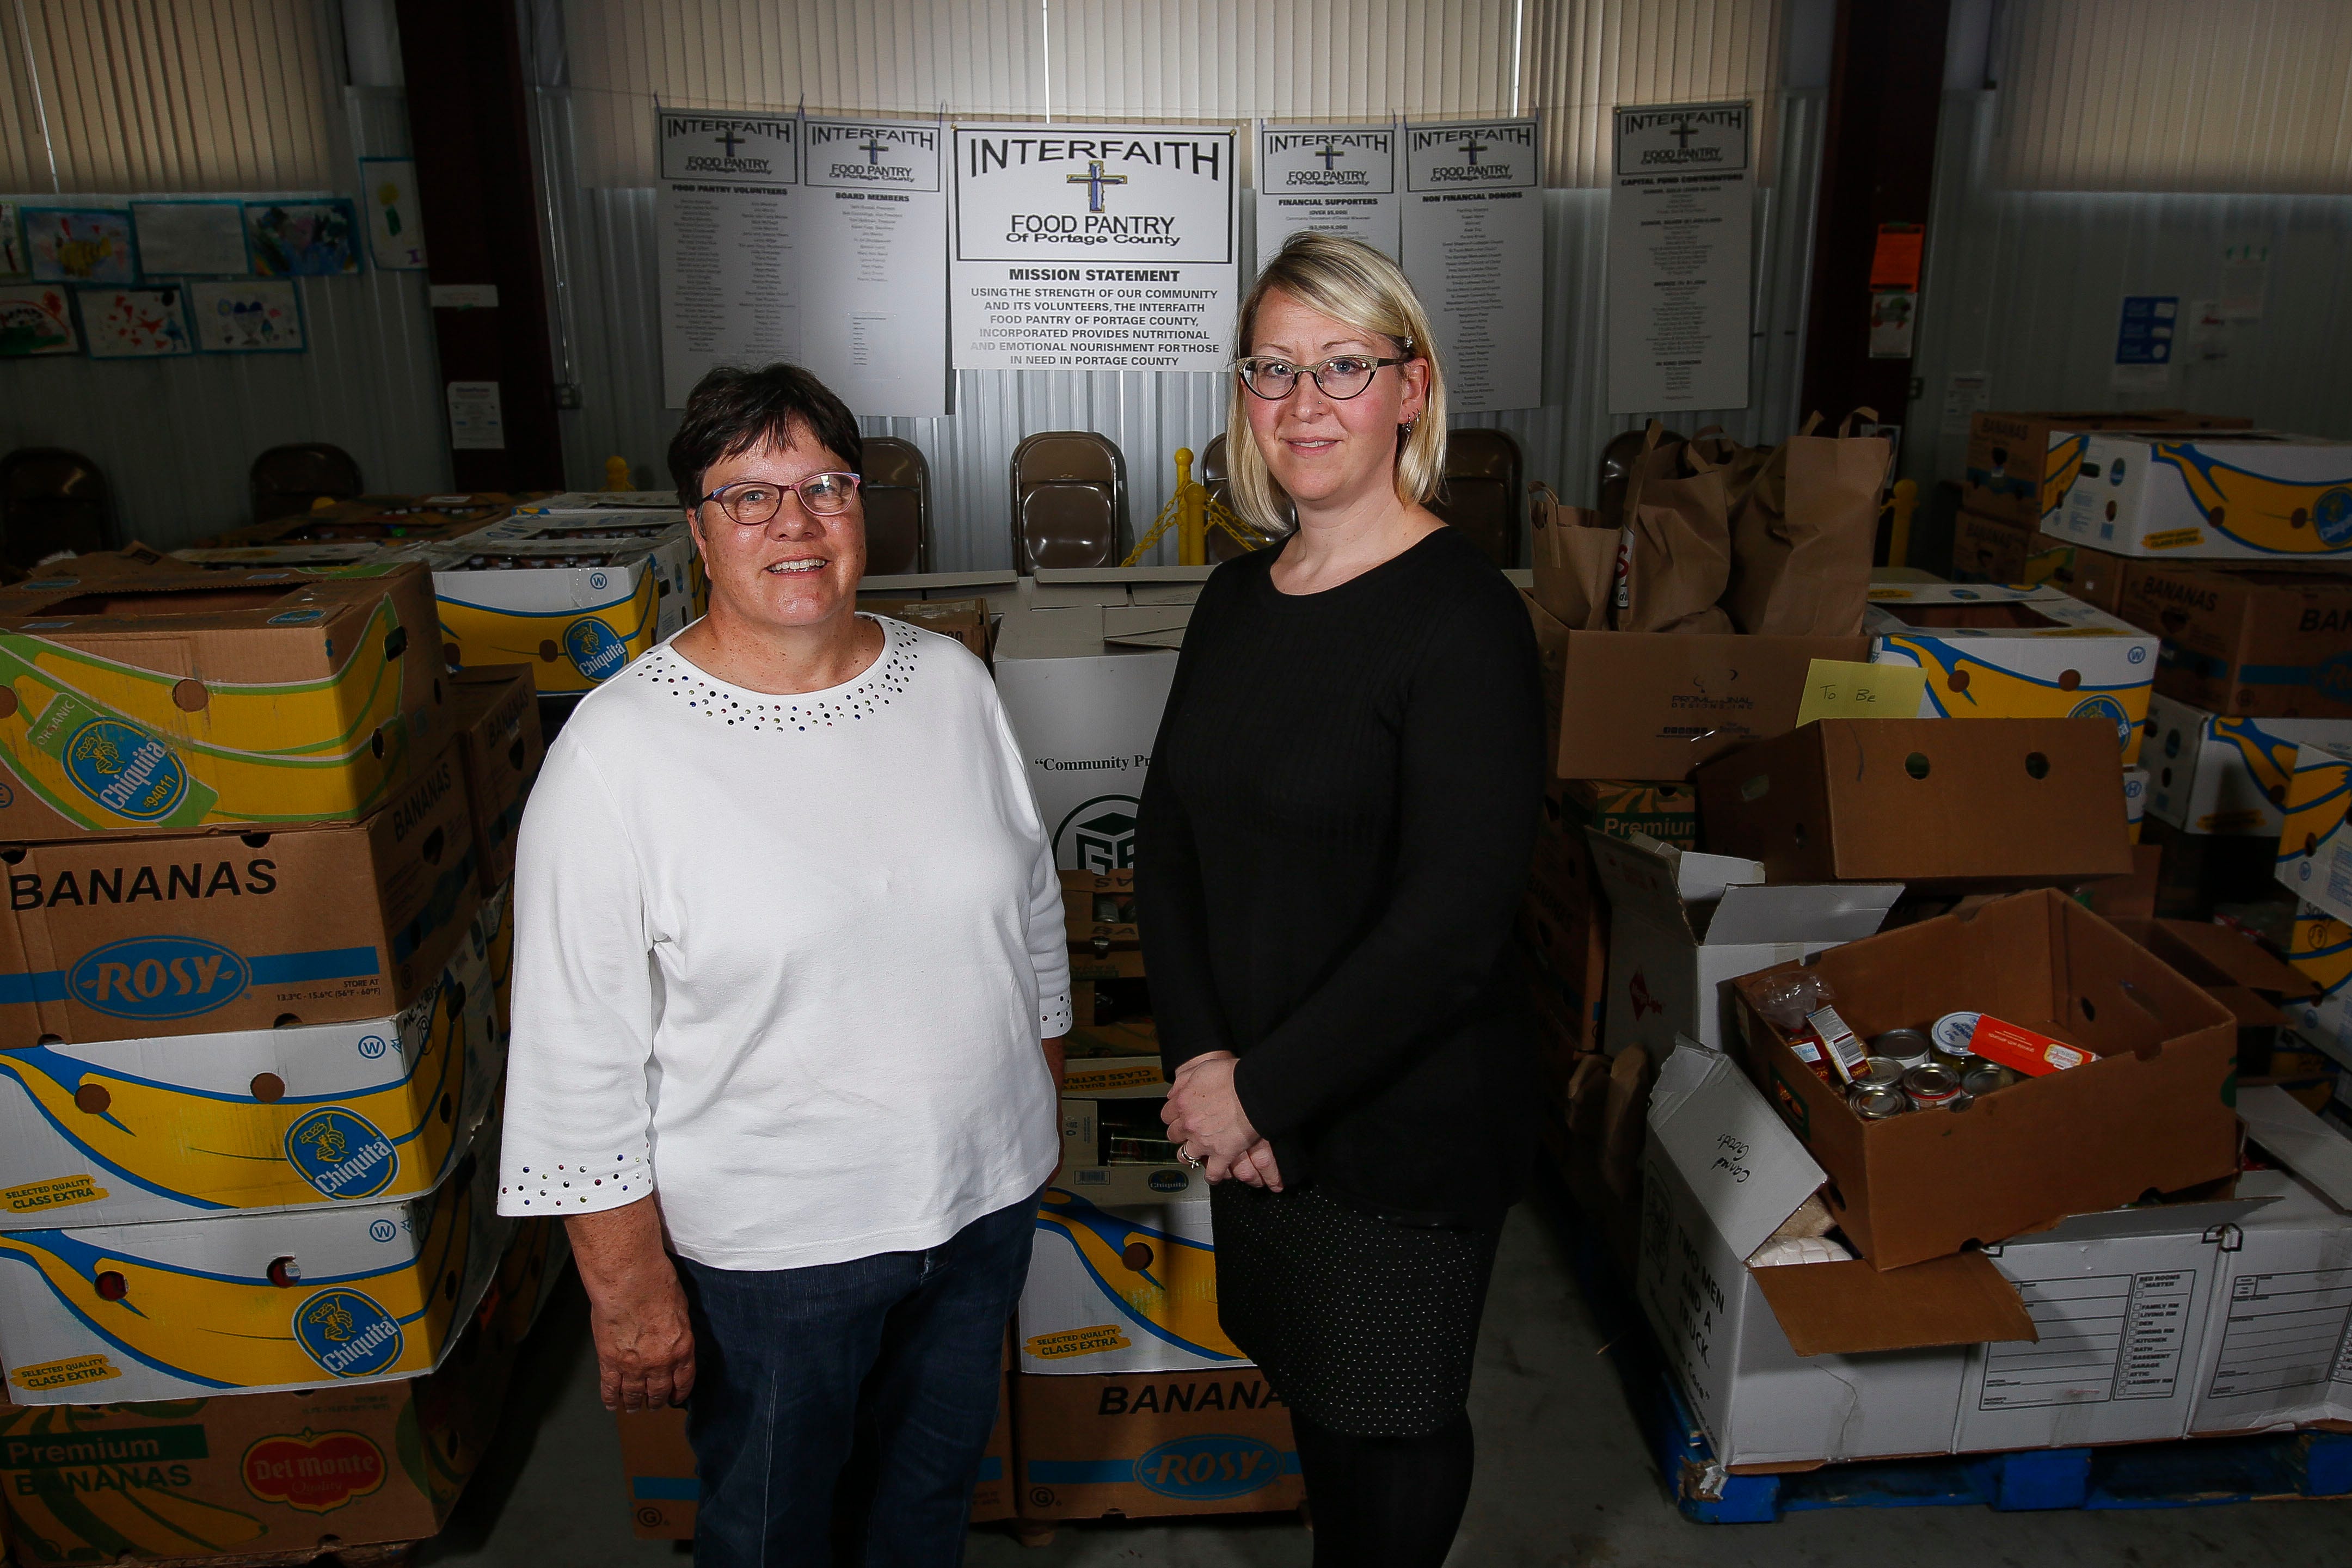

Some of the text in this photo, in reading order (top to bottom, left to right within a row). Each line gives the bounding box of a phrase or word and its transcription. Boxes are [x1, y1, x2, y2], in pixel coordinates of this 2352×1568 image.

[667, 118, 790, 143] INTERFAITH
[1625, 111, 1741, 134] INTERFAITH
[812, 126, 933, 151] INTERFAITH
[1269, 134, 1387, 154] INTERFAITH
[1414, 127, 1530, 152] INTERFAITH
[688, 156, 769, 170] FOOD PANTRY
[971, 138, 1219, 181] INTERFAITH
[1643, 147, 1721, 160] FOOD PANTRY
[831, 164, 912, 176] FOOD PANTRY
[1288, 171, 1367, 181] FOOD PANTRY
[1433, 165, 1510, 176] FOOD PANTRY
[733, 186, 788, 195] VOLUNTEERS
[1011, 215, 1175, 235] FOOD PANTRY
[1006, 233, 1180, 246] Of Portage County
[1009, 269, 1180, 282] MISSION STATEMENT
[972, 288, 1218, 299] USING THE STRENGTH OF OUR COMMUNITY
[984, 302, 1205, 313] AND ITS VOLUNTEERS, THE INTERFAITH
[991, 315, 1199, 327] FOOD PANTRY OF PORTAGE COUNTY,
[980, 329, 1209, 339] INCORPORATED PROVIDES NUTRITIONAL
[971, 342, 1219, 353] AND EMOTIONAL NOURISHMENT FOR THOSE
[1010, 356, 1180, 366] IN NEED IN PORTAGE COUNTY
[2143, 575, 2218, 612] BANANAS
[579, 642, 625, 677] Chiquita
[1820, 685, 1876, 702] To Be
[37, 700, 75, 746] ORGANIC
[1134, 754, 1150, 767] Pr
[99, 741, 167, 810] Chiquita
[143, 774, 176, 809] #94011
[393, 763, 451, 843] BANANAS
[10, 858, 278, 911] BANANAS
[95, 955, 223, 1003] ROSY
[343, 980, 367, 988] STORE
[277, 992, 302, 1001] 13.3°C
[308, 991, 333, 999] 15.6°C
[364, 1041, 380, 1054] W
[1063, 1069, 1151, 1084] CLASS EXTRA
[1063, 1075, 1158, 1090] SELECTED QUALITY
[1717, 1134, 1749, 1161] Goods
[315, 1139, 392, 1194] Chiquita
[5, 1178, 91, 1200] SELECTED QUALITY
[1150, 1181, 1187, 1190] Chiquita
[13, 1188, 95, 1209] CLASS EXTRA
[374, 1225, 391, 1238] W
[1678, 1224, 1724, 1315] TWO MEN
[1681, 1271, 1712, 1335] AND A
[322, 1318, 398, 1373] Chiquita
[1036, 1328, 1117, 1346] SELECTED QUALITY
[1041, 1337, 1119, 1356] CLASS EXTRA
[21, 1358, 103, 1378] SELECTED QUALITY
[28, 1367, 108, 1387] CLASS EXTRA
[1098, 1381, 1285, 1415] BANANA
[7, 1436, 161, 1465] Premium
[254, 1452, 377, 1480] Del Monte
[1154, 1449, 1266, 1487] ROSY
[15, 1464, 193, 1496] BANANAS
[291, 1480, 343, 1495] Quality
